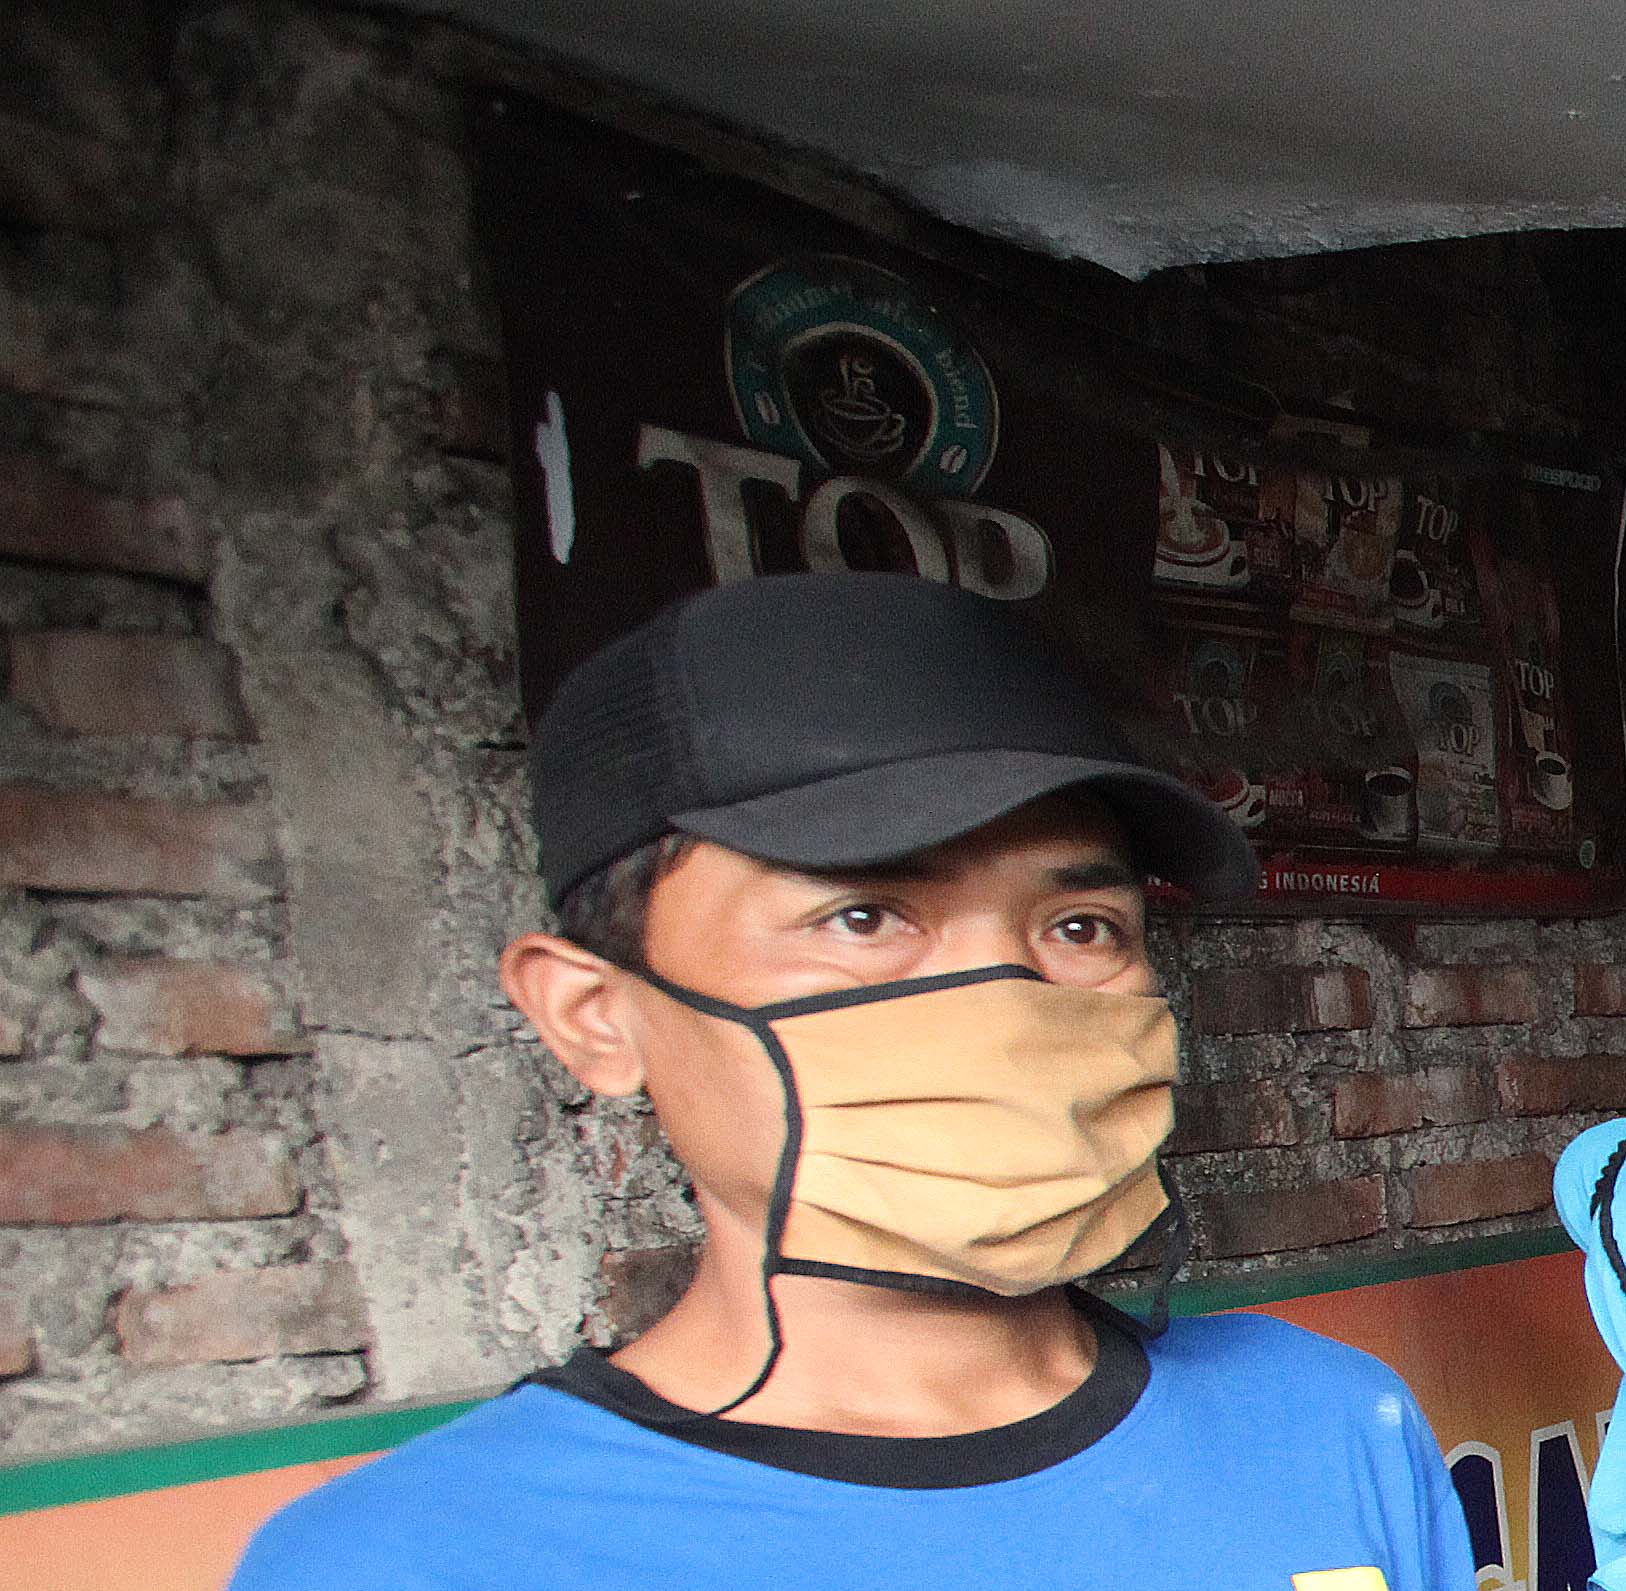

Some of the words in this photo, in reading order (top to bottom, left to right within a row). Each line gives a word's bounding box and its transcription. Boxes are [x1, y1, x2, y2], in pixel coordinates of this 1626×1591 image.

[636, 422, 1056, 601] TOP
[1415, 494, 1459, 545] TOP
[1515, 659, 1554, 700] TOP
[1274, 870, 1382, 895] INDONESIA
